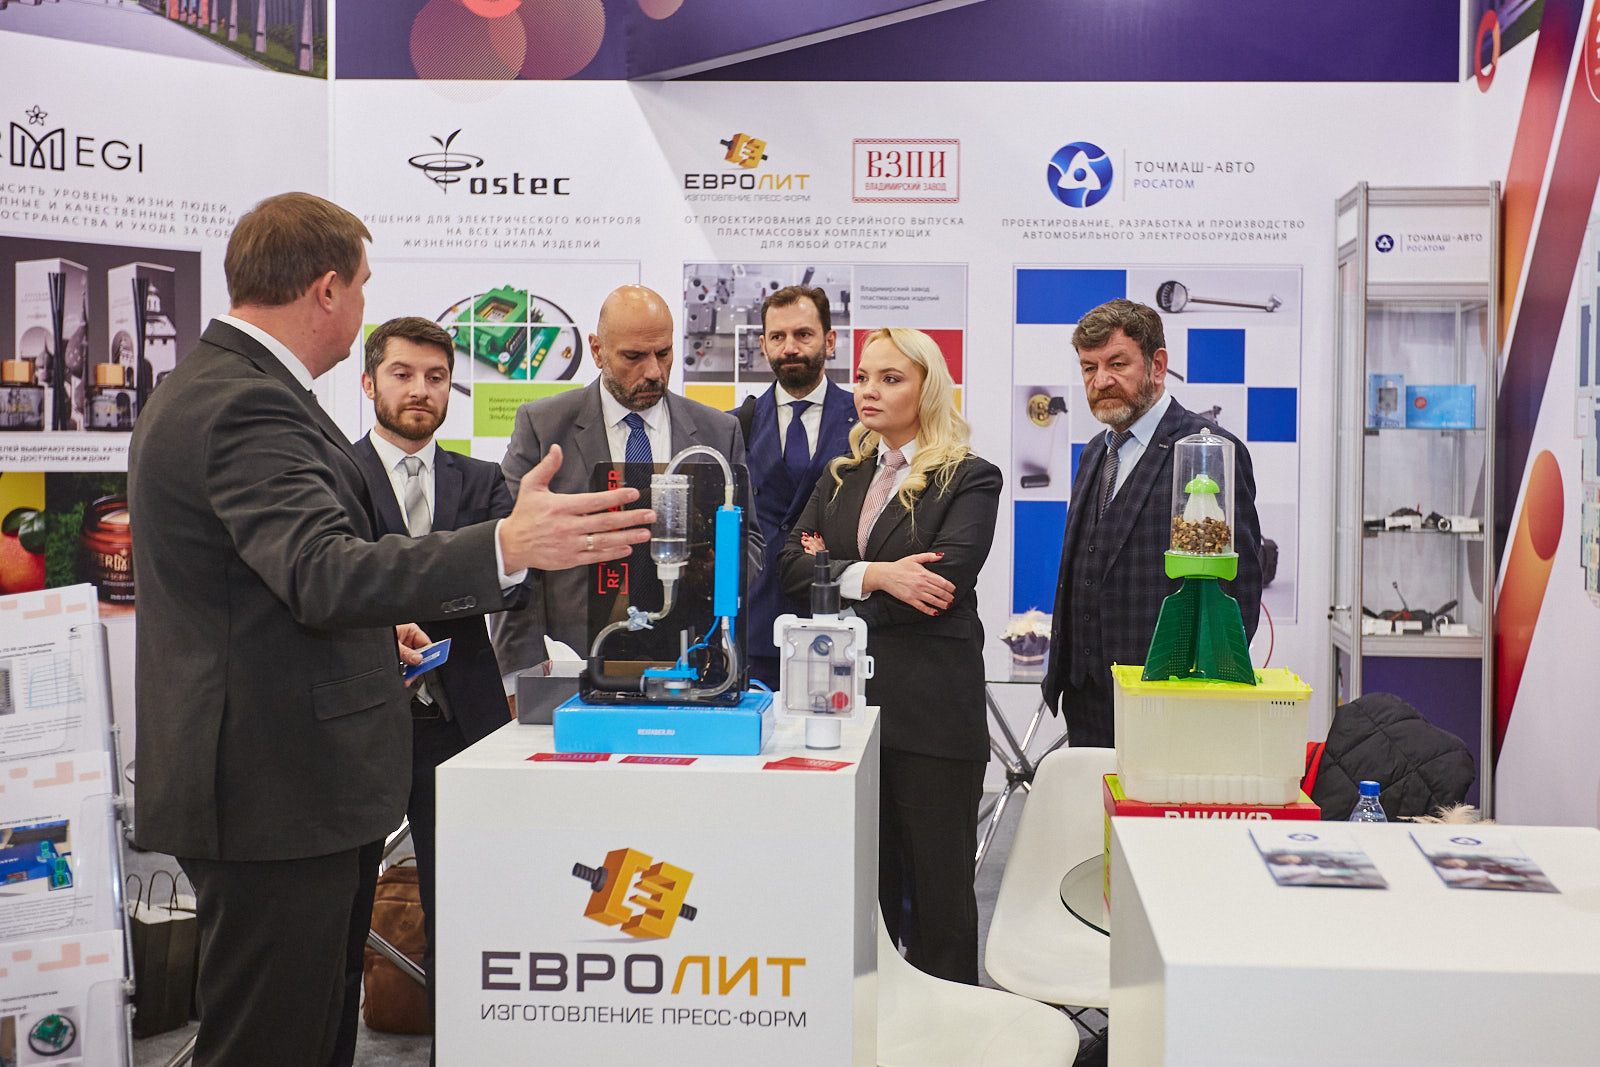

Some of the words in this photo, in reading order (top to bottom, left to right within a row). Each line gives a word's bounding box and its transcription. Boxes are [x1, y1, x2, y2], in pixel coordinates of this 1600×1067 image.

[0, 121, 143, 173] MEGI
[865, 150, 946, 178] ВЗПИ
[1135, 161, 1256, 173] ТОЧМАШ-АВТО
[470, 172, 570, 195] ostec
[684, 173, 811, 190] ЕВРОЛИТ
[865, 182, 921, 191] ВЛАДИМИРСКИЙ
[923, 183, 947, 192] ЗАВОД
[1134, 179, 1196, 189] РОСАТОМ
[53, 187, 119, 203] УРОВЕНЬ
[126, 195, 175, 208] ЖИЗНИ
[684, 194, 751, 202] ИЗГОТОВЛЕНИЕ
[753, 194, 812, 202] ПРЕСС-ФОРМ
[48, 201, 57, 211] И
[64, 203, 176, 222] КАЧЕСТВЕННЫЕ
[363, 215, 421, 224] РЕШЕНИЯ
[426, 215, 451, 225] ДЛЯ
[456, 215, 569, 225] ЭЛЕКТРИЧЕСКОГО
[574, 216, 642, 225] КОНТРОЛЯ
[684, 215, 699, 225] ОТ
[703, 215, 812, 225] ПРОЕКТИРОВАНИЯ
[815, 216, 832, 226] ДО
[837, 215, 906, 225] СЕРИЙНОГО
[910, 216, 965, 226] ВЫПУСКА
[1001, 218, 1114, 229] ПРОЕКТИРОВАНИЕ,
[1119, 219, 1193, 228] РАЗРАБОТКА
[1197, 219, 1205, 228] И
[1210, 219, 1305, 230] ПРОИЗВОДСТВО
[115, 220, 124, 230] И
[131, 222, 176, 234] УХОДА
[184, 226, 199, 236] ЗА
[446, 227, 462, 236] НА
[468, 227, 499, 236] ВСЕХ
[505, 227, 553, 236] ЭТАПАХ
[717, 228, 820, 237] ПЛАСТМАССОВЫХ
[825, 229, 931, 238] КОМПЛЕКТУЮЩИХ
[1022, 231, 1134, 240] АВТОМОБИЛЬНОГО
[1139, 231, 1288, 241] ЭЛЕКТРООБОРУДОВАНИЯ
[1407, 233, 1483, 242] ТОЧМАШ-АВТО
[402, 239, 488, 248] ЖИЗНЕННОГО
[494, 239, 537, 249] ЦИКЛА
[542, 238, 601, 249] ИЗДЕЛИЙ
[760, 240, 783, 250] ДЛЯ
[787, 239, 829, 250] ЛЮБОЙ
[834, 240, 888, 250] ОТРАСЛИ
[1406, 244, 1446, 252] РОСАТОМ
[481, 951, 806, 997] ЕВРОЛИТ
[480, 1004, 654, 1025] ИЗГОТОВЛЕНИЕ
[662, 1008, 807, 1028] ПРЕСС-ФОРМ
